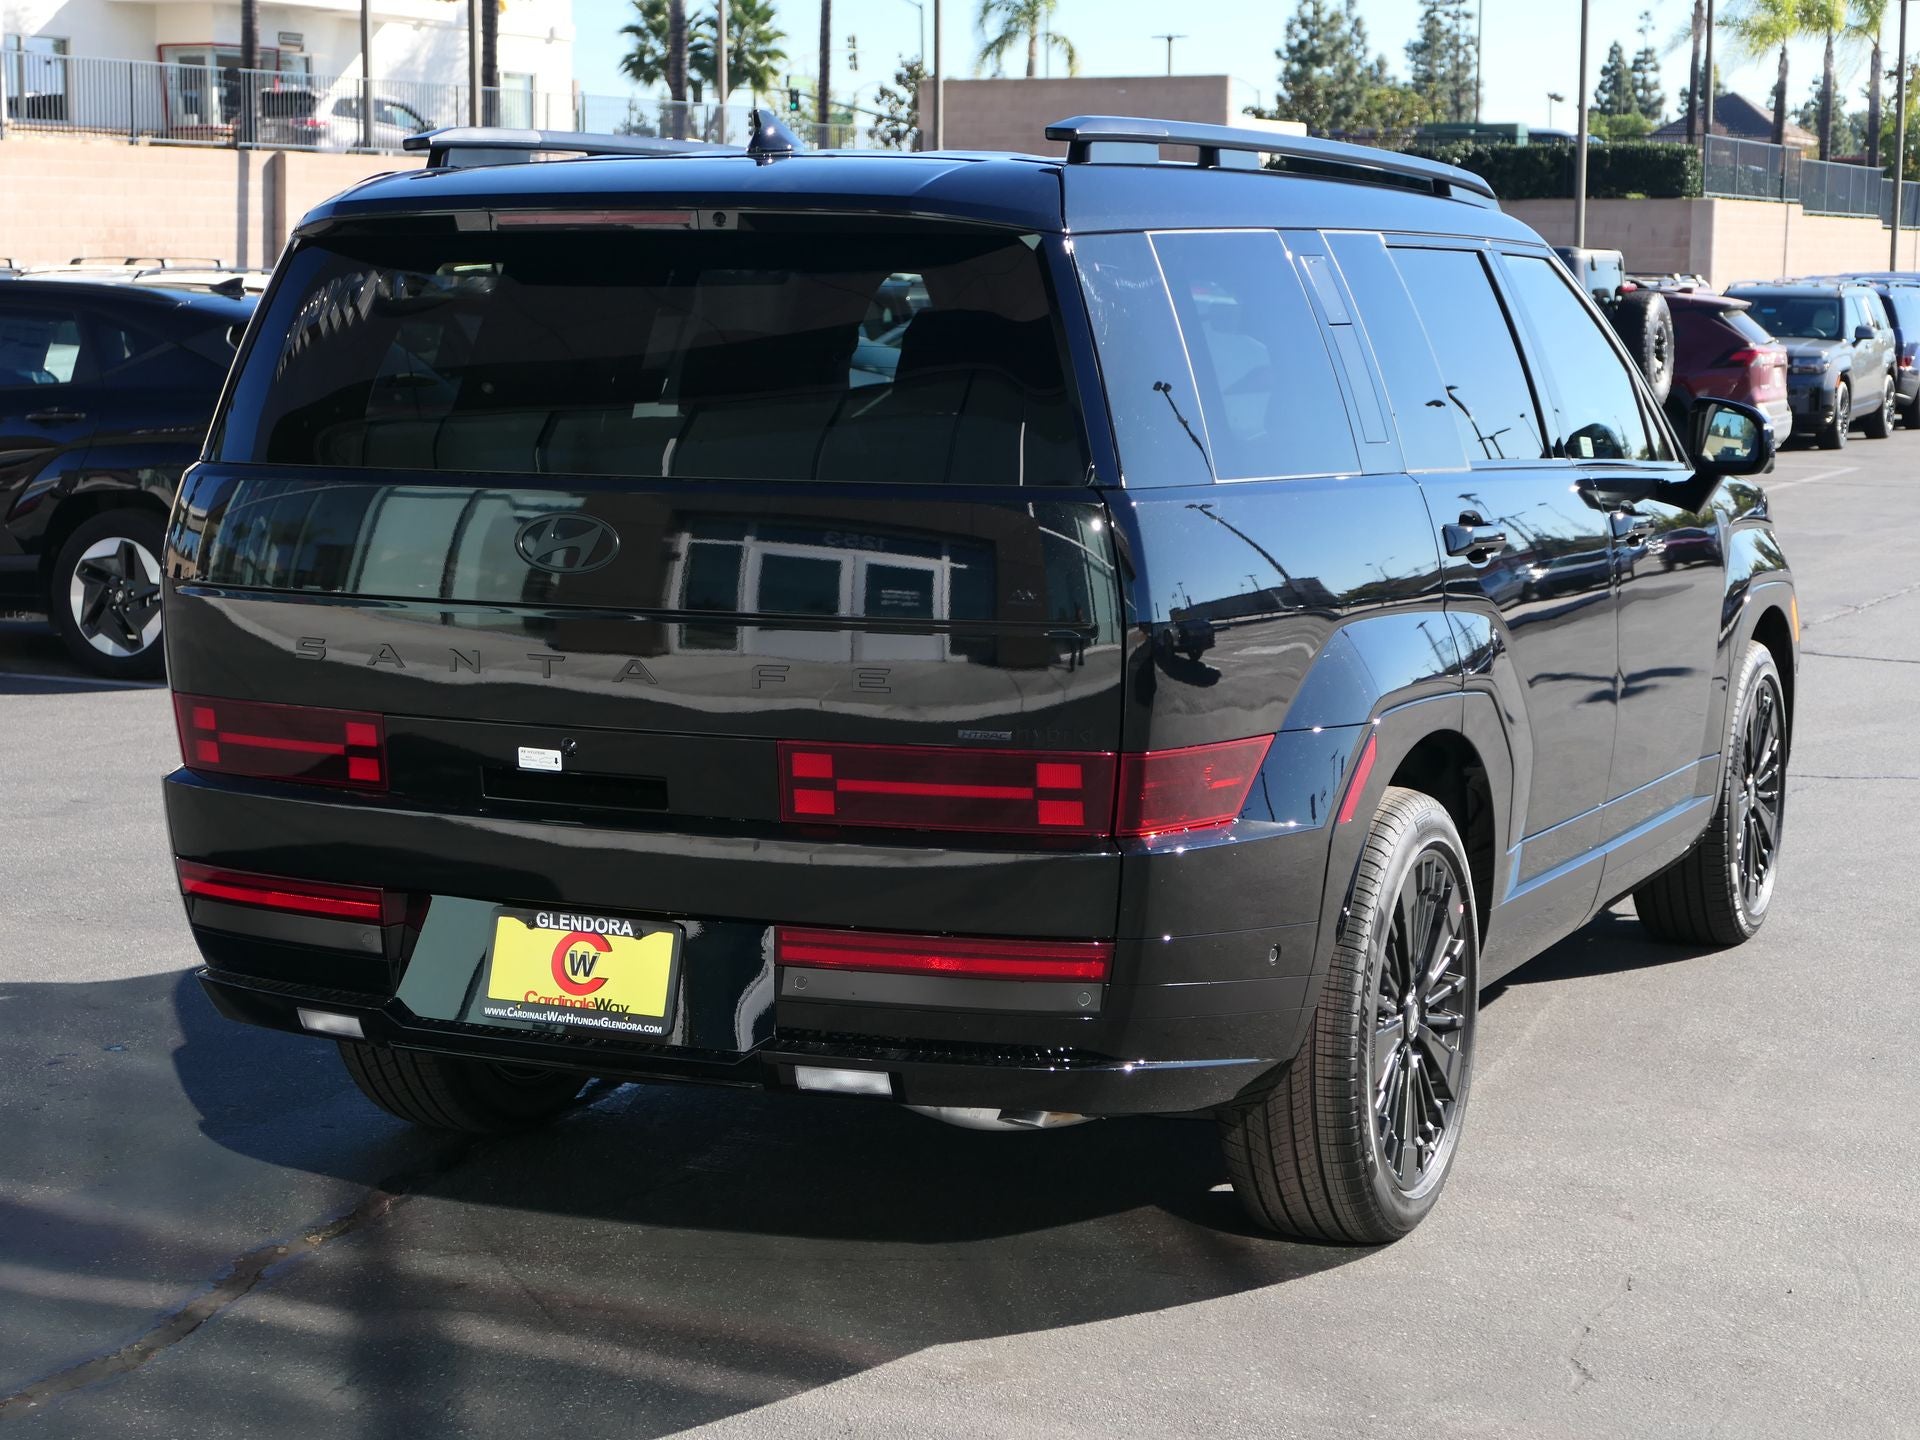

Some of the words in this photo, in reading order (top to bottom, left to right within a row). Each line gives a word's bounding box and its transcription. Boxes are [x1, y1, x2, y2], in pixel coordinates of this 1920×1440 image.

[295, 636, 658, 685] SANTA
[751, 664, 892, 694] FE
[960, 729, 1012, 741] HTRAC
[536, 911, 634, 937] GLENDORA
